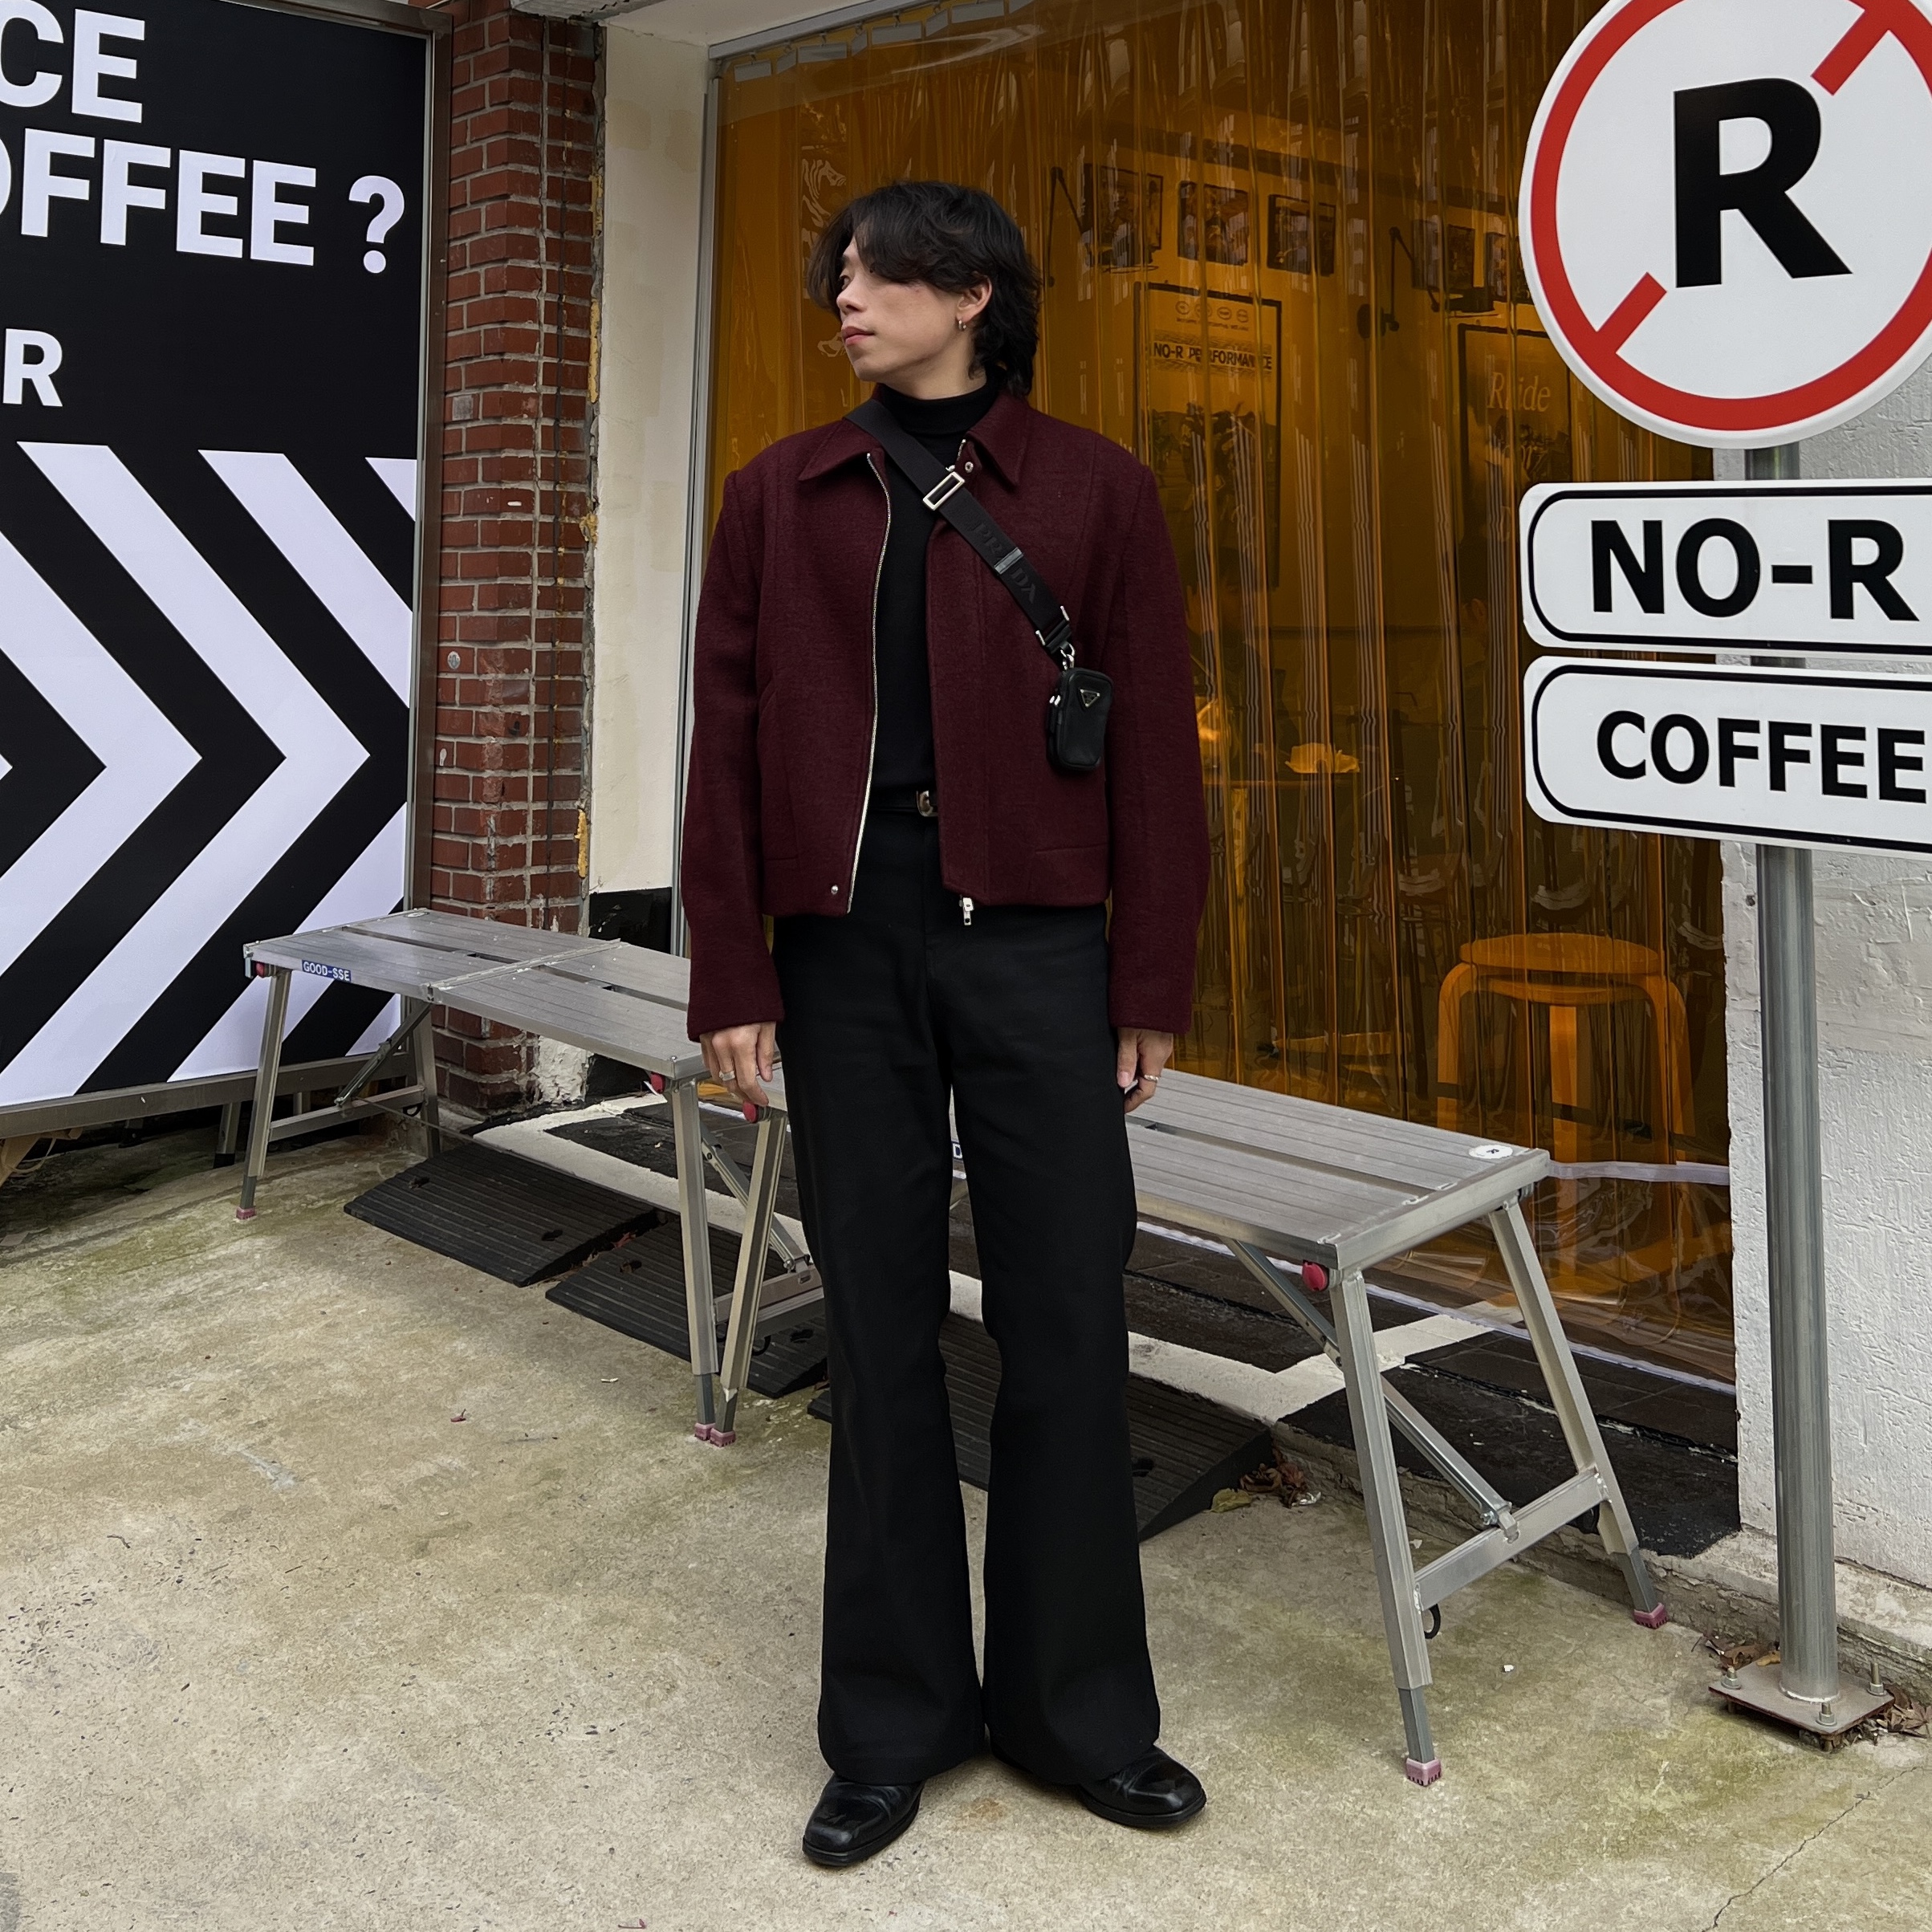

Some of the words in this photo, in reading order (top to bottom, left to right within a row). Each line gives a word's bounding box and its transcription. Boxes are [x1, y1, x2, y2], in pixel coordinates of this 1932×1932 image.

[0, 128, 317, 266] FFEE
[348, 175, 405, 274] ?
[1674, 78, 1853, 288] R
[2, 327, 63, 407] R
[1153, 342, 1184, 359] NO-R
[969, 522, 1036, 604] PRDA
[1590, 518, 1920, 621] NO-R
[1596, 710, 1927, 804] COFFEE
[303, 961, 351, 982] GOOD-SSE
